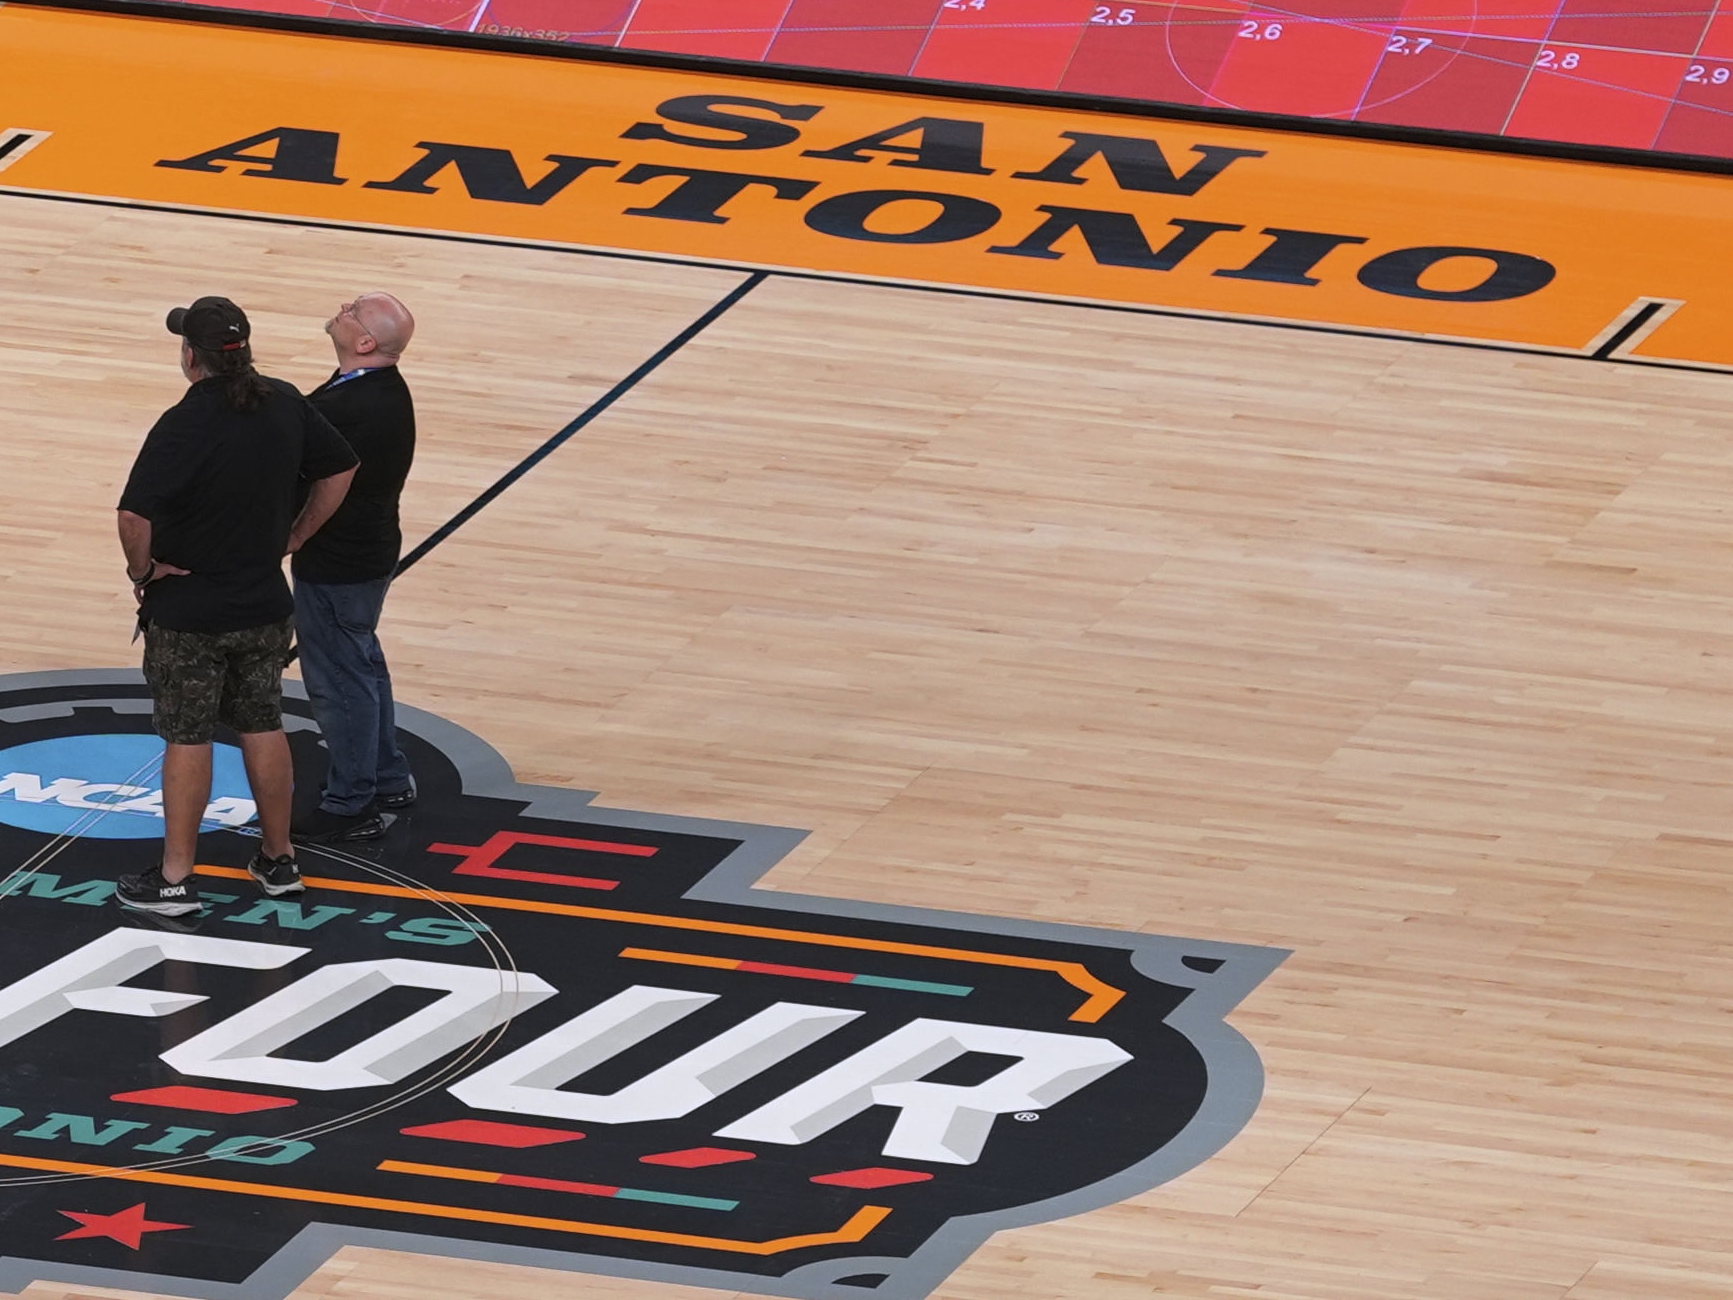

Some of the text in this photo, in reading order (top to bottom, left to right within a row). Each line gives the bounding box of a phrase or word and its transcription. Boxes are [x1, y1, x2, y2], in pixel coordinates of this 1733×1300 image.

[1090, 5, 1134, 27] 2,5
[1238, 19, 1282, 41] 2,6
[1387, 35, 1432, 56] 2,7
[1535, 49, 1580, 71] 2,8
[1685, 65, 1730, 85] 2,9
[618, 92, 1269, 199] SAN
[153, 123, 1558, 307] ANTONIO
[160, 886, 186, 897] HOKA
